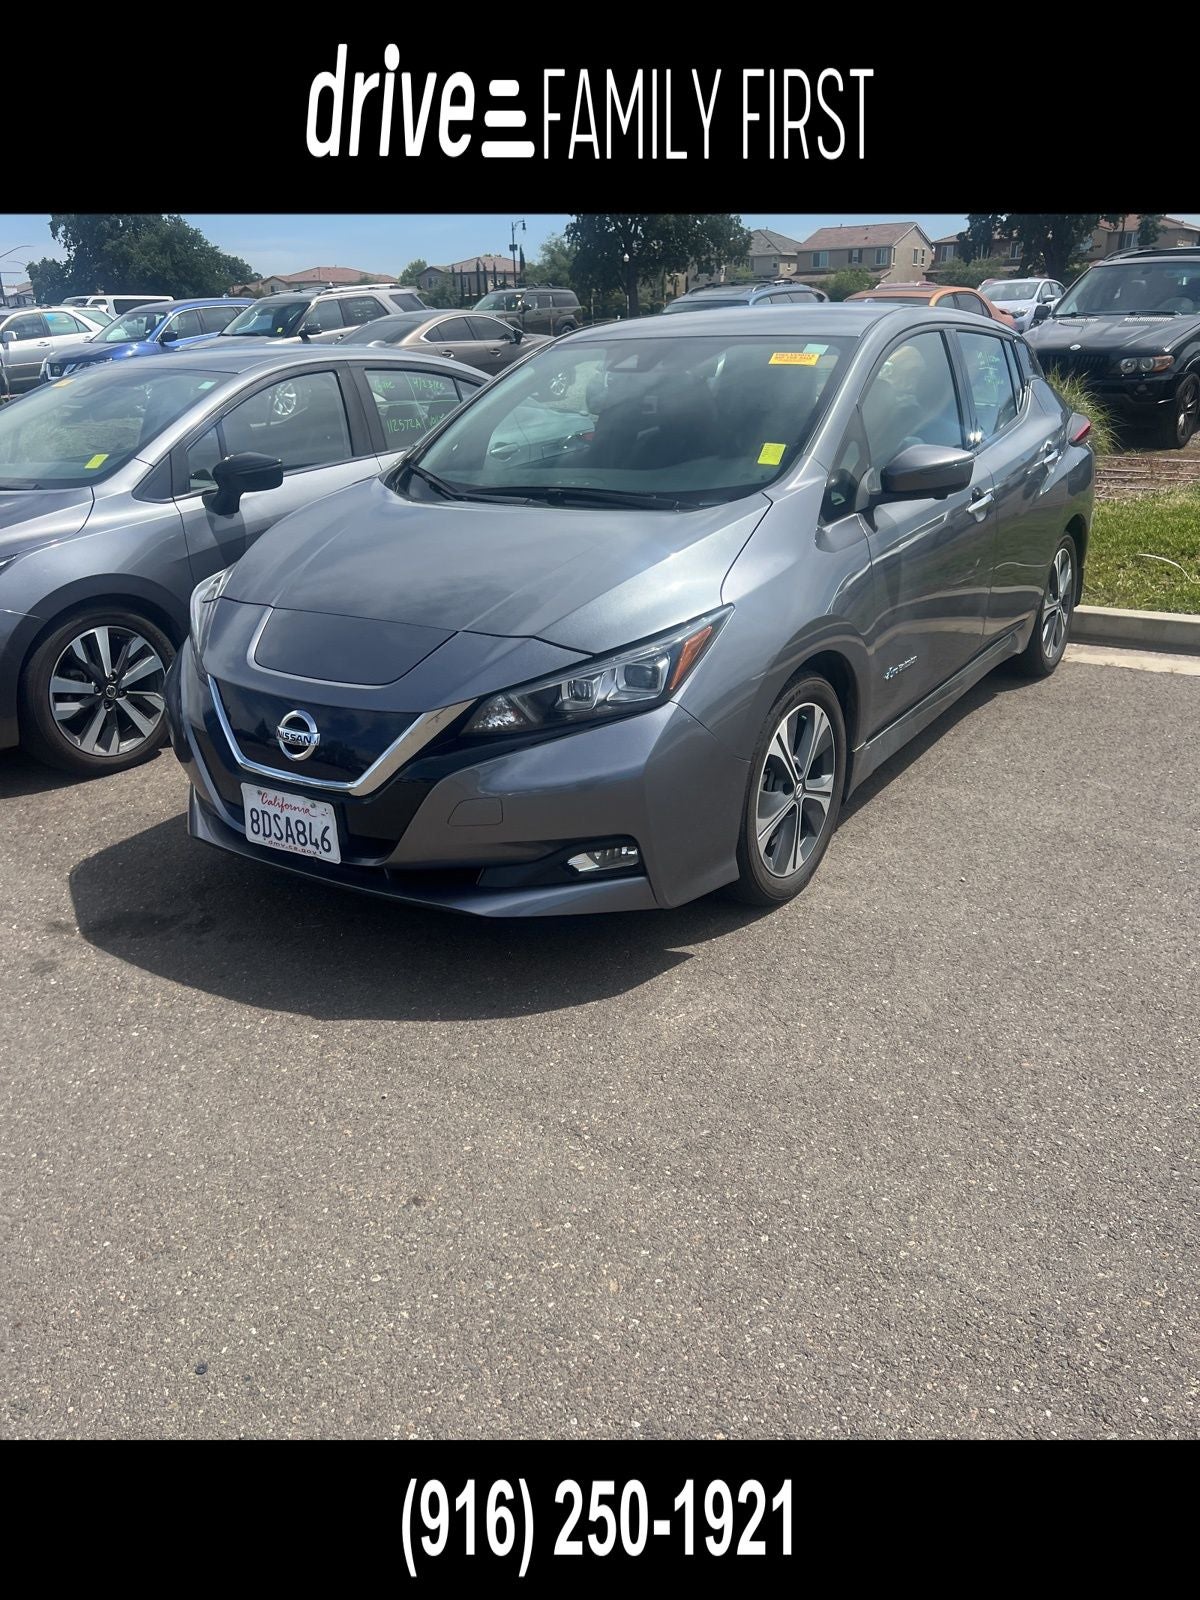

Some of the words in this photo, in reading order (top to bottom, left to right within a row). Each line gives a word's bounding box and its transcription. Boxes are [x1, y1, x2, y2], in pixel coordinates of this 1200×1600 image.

[277, 728, 312, 745] NISSAN
[261, 791, 317, 818] California
[250, 807, 332, 853] 8DSA846
